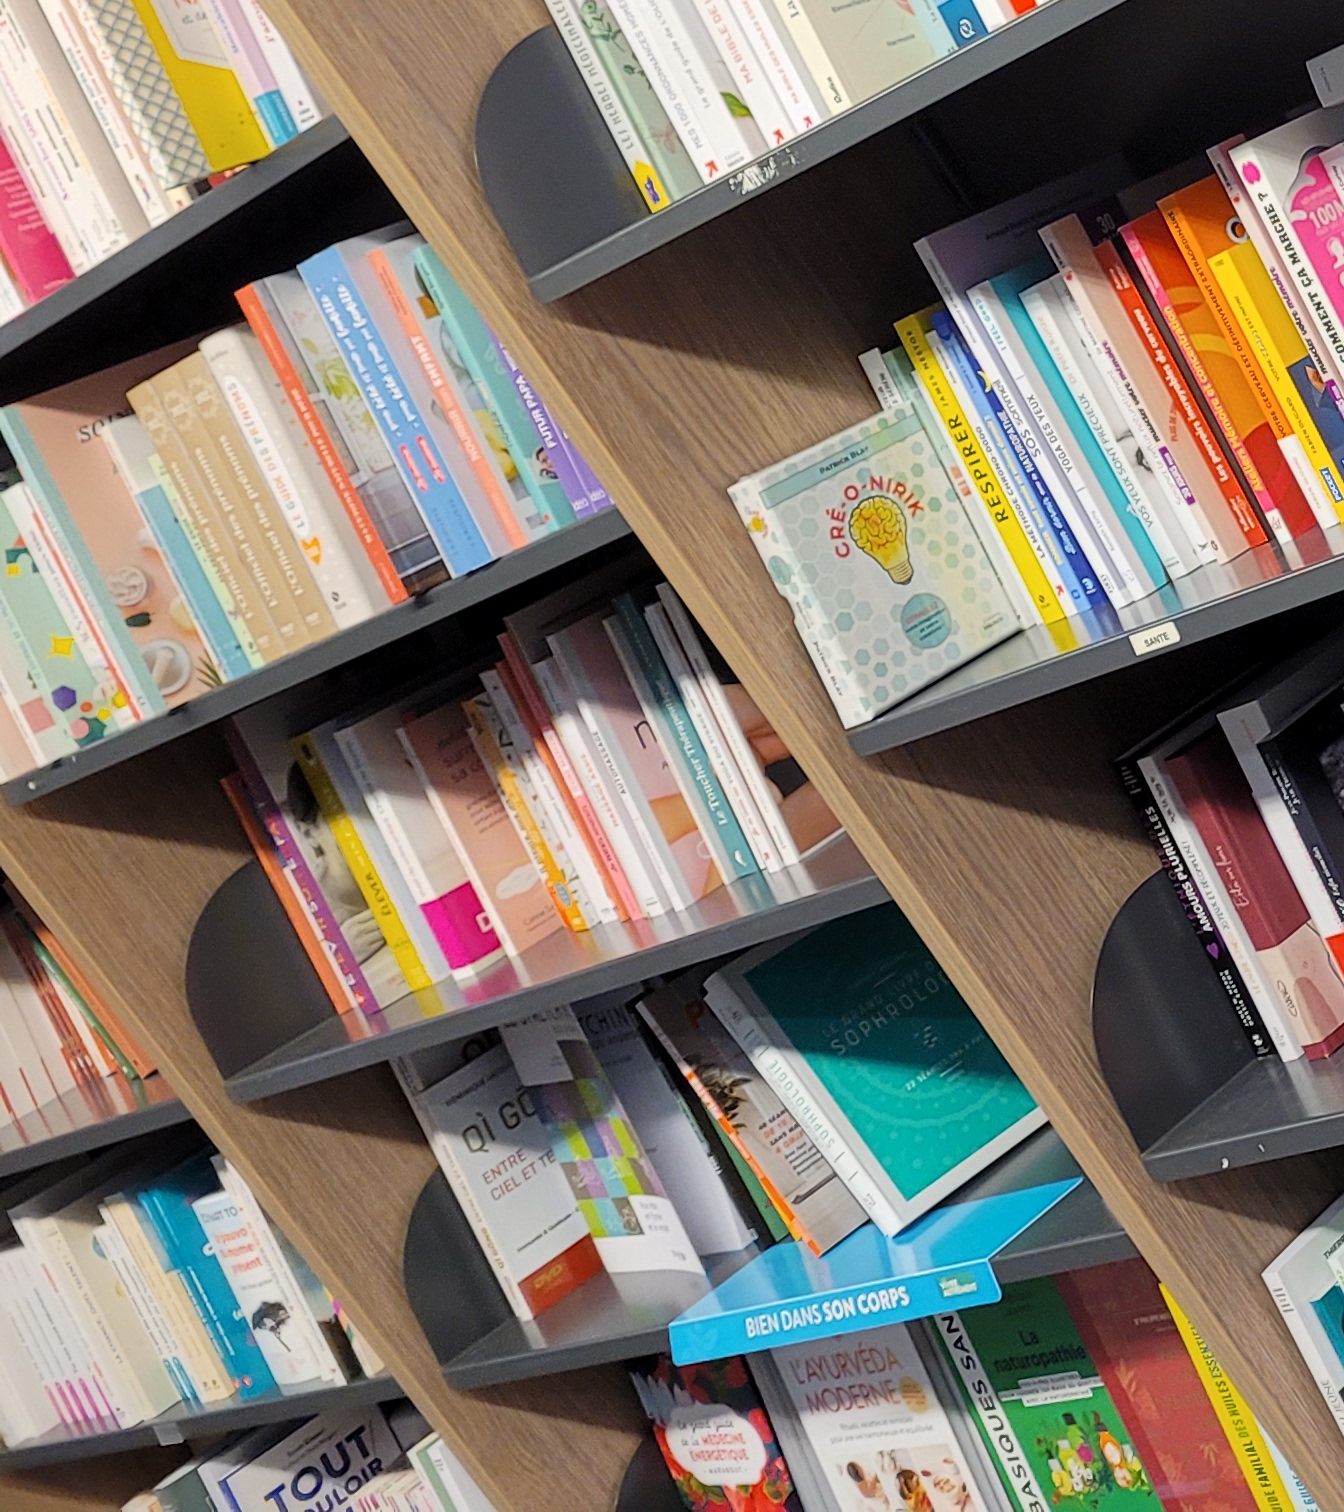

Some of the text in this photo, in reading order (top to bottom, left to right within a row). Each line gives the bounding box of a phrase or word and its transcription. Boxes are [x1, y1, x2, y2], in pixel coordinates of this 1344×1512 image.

[947, 413, 1009, 524] RESPIRER
[829, 475, 925, 559] CRÉ-O-NIRIK
[482, 1148, 527, 1184] ENTRE
[744, 1286, 910, 1339] BIEN DANS SON CORPS
[790, 1345, 901, 1385] L'AYURVÉDA
[805, 1380, 900, 1416] MODERNE
[263, 1424, 370, 1512] TOUT
